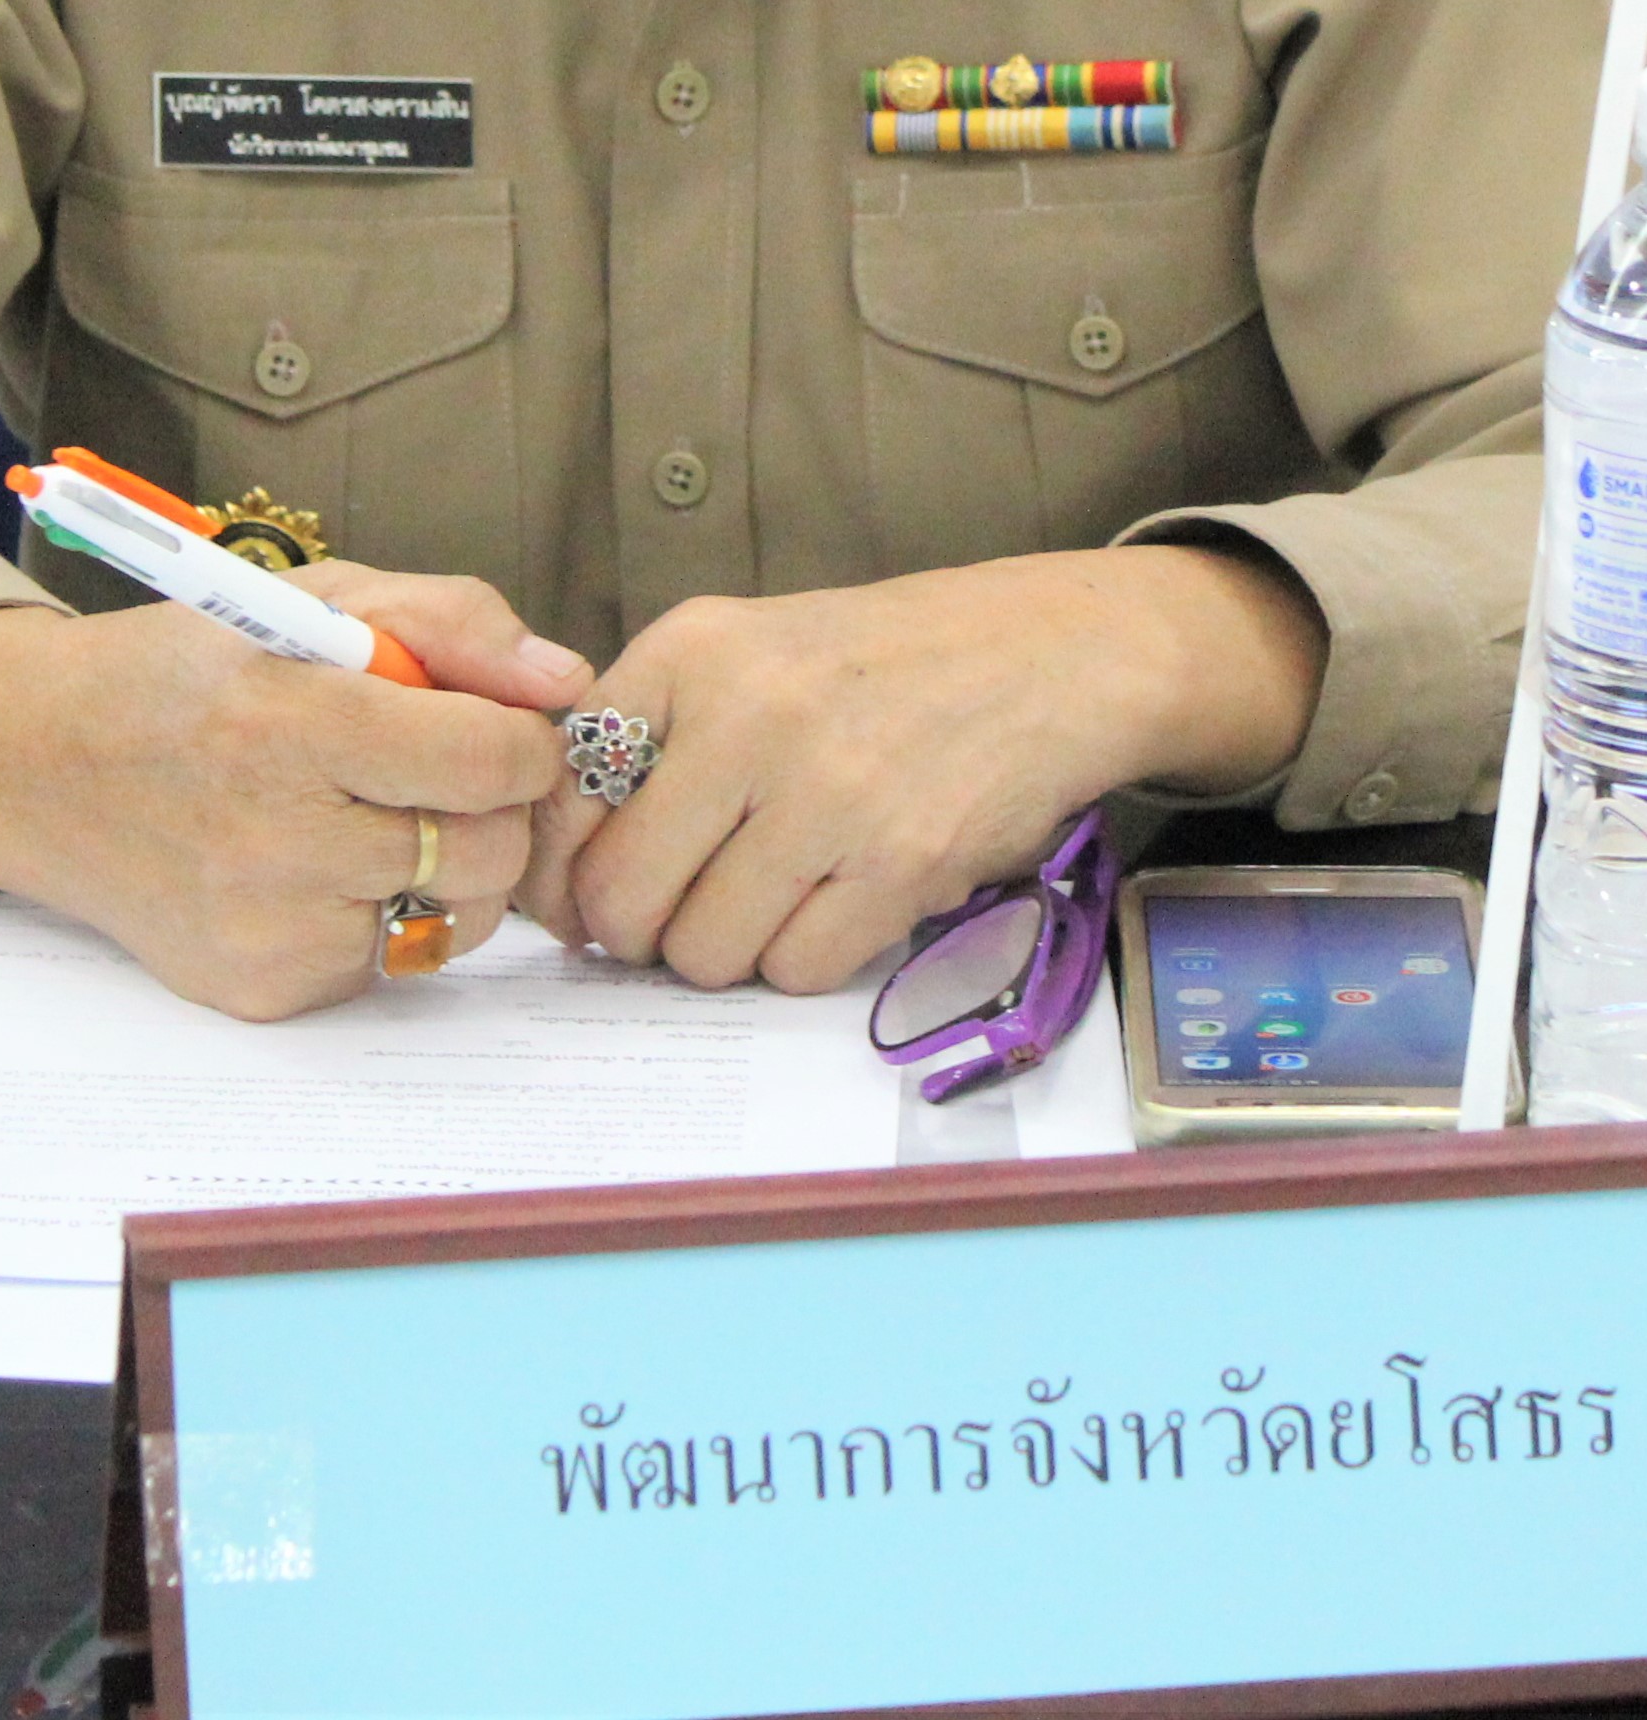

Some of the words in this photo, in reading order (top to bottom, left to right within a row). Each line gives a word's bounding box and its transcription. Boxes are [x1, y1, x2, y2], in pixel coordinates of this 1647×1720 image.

[538, 1351, 1620, 1515] พัฒนาการจังหวัดยโสธร
